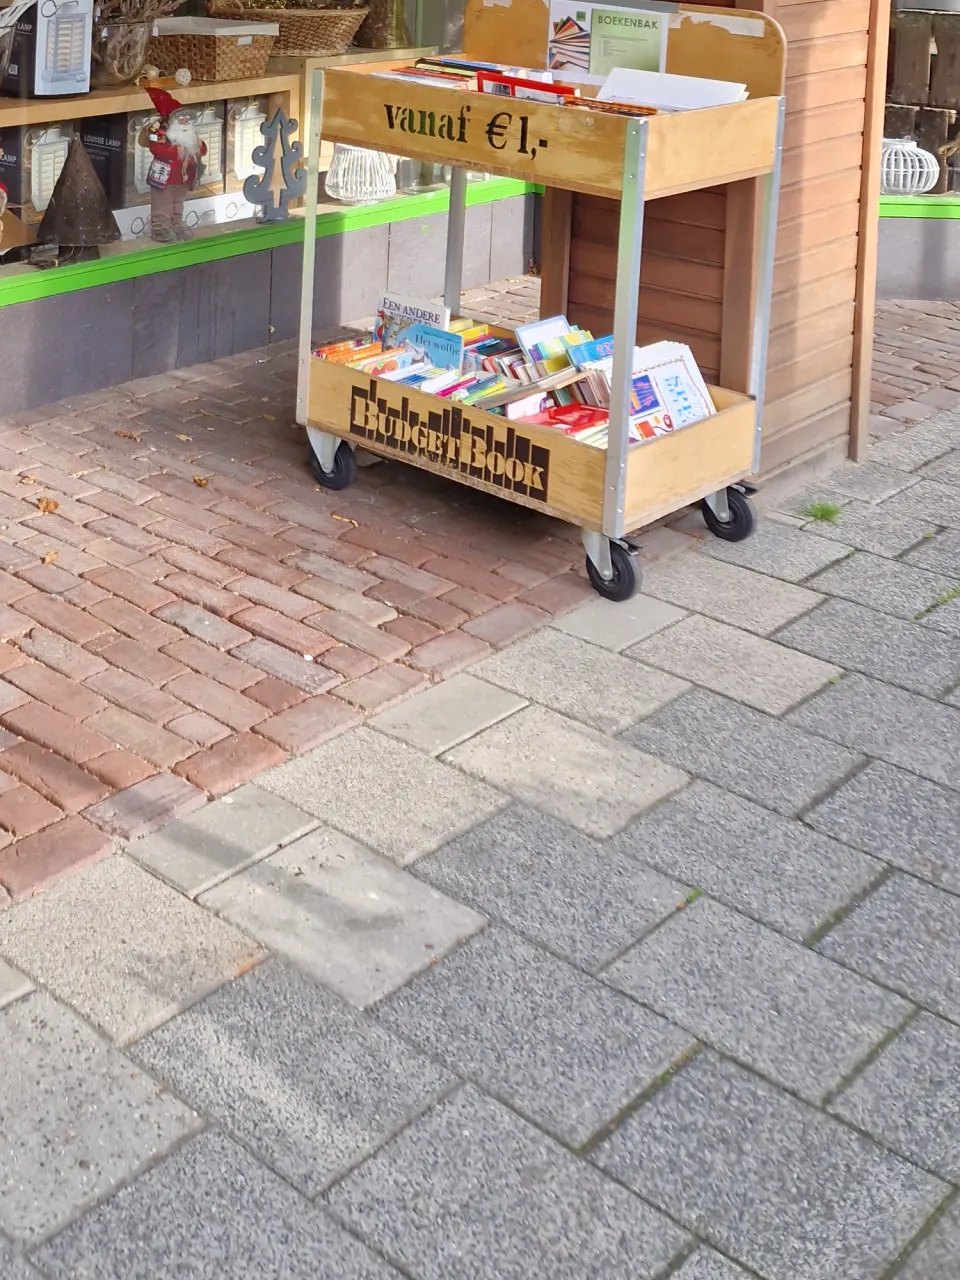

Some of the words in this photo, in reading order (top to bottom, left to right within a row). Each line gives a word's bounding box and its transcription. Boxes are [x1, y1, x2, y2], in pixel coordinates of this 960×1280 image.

[17, 22, 33, 32] LAMP
[597, 15, 659, 30] BOEKENBAK
[83, 134, 105, 145] LOUVRE
[105, 137, 122, 148] LAMP
[383, 103, 472, 145] vanaf
[485, 111, 549, 161] €1,-
[382, 297, 401, 312] EEN
[402, 304, 441, 324] ANDERE
[415, 333, 432, 347] Het
[434, 341, 460, 356] wolfje
